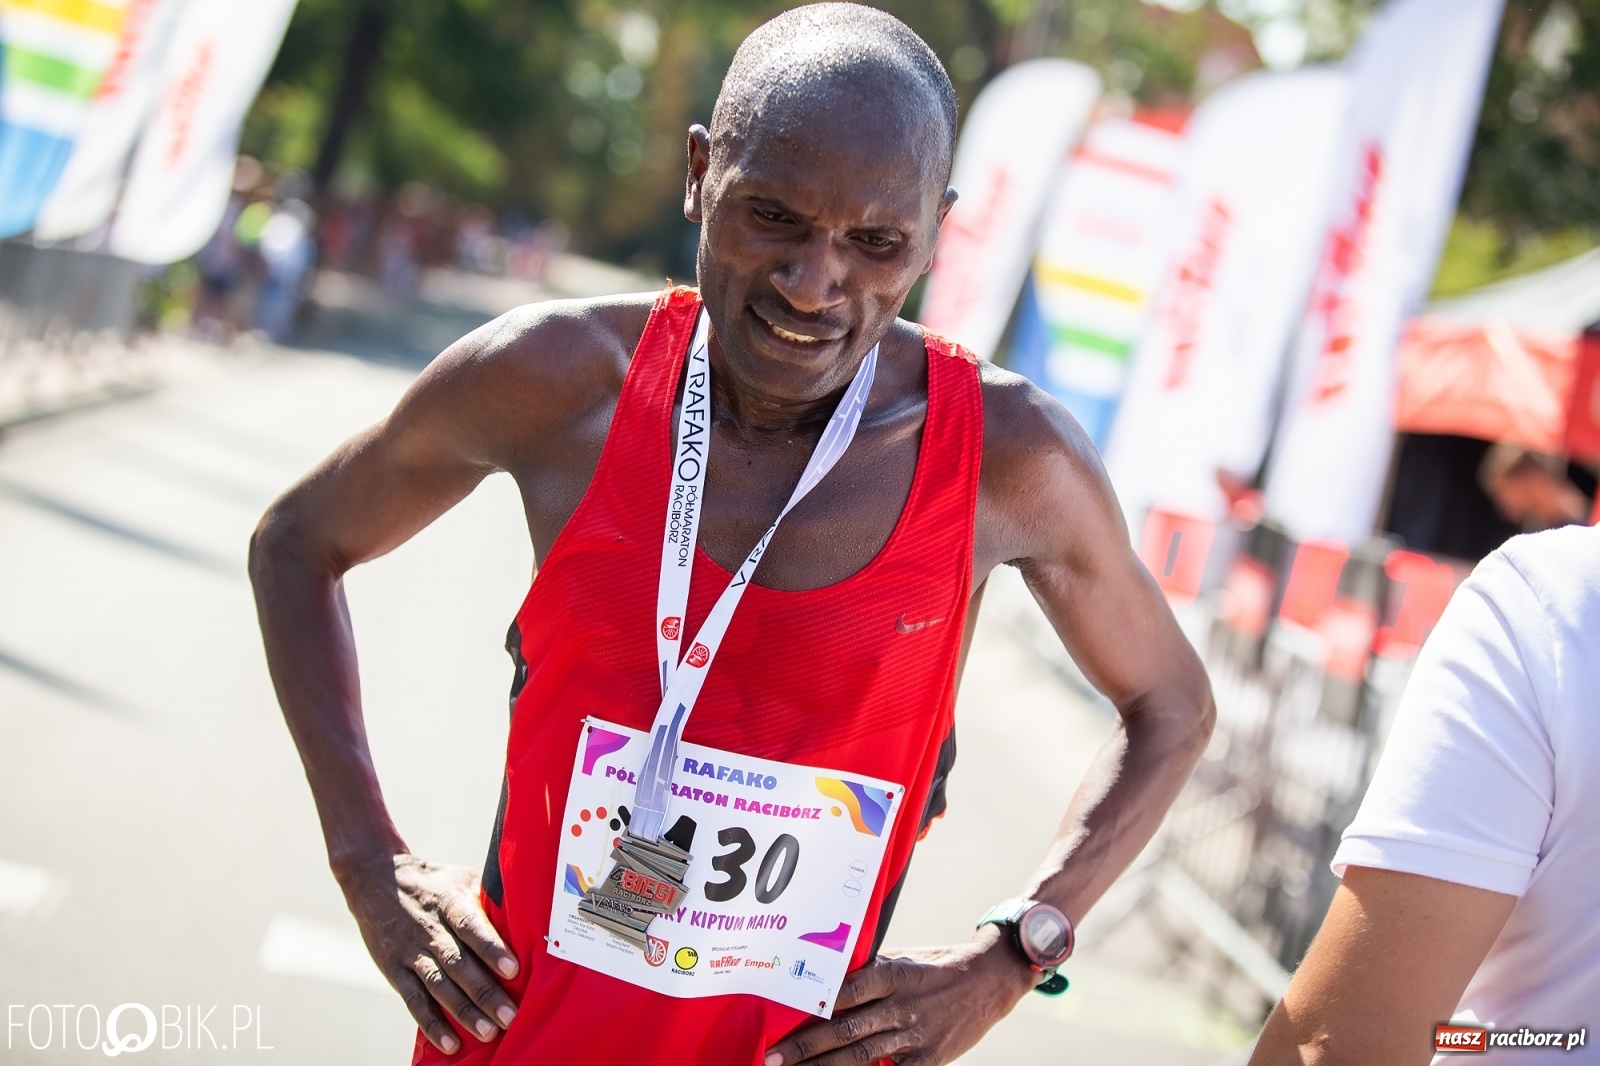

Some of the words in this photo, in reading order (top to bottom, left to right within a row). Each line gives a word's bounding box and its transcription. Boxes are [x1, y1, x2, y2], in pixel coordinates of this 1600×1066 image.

[678, 372, 706, 482] RAFAKO
[668, 485, 685, 543] RACIBÓRZ
[678, 485, 698, 567] PÓŁMARATON
[605, 765, 728, 808] PÓŁRATON
[734, 797, 822, 820] RACIBÓRZ
[683, 758, 777, 790] RAFAKO
[622, 868, 678, 906] BIEGI
[690, 910, 745, 931] KIPTUM
[746, 914, 788, 931] MAIYO
